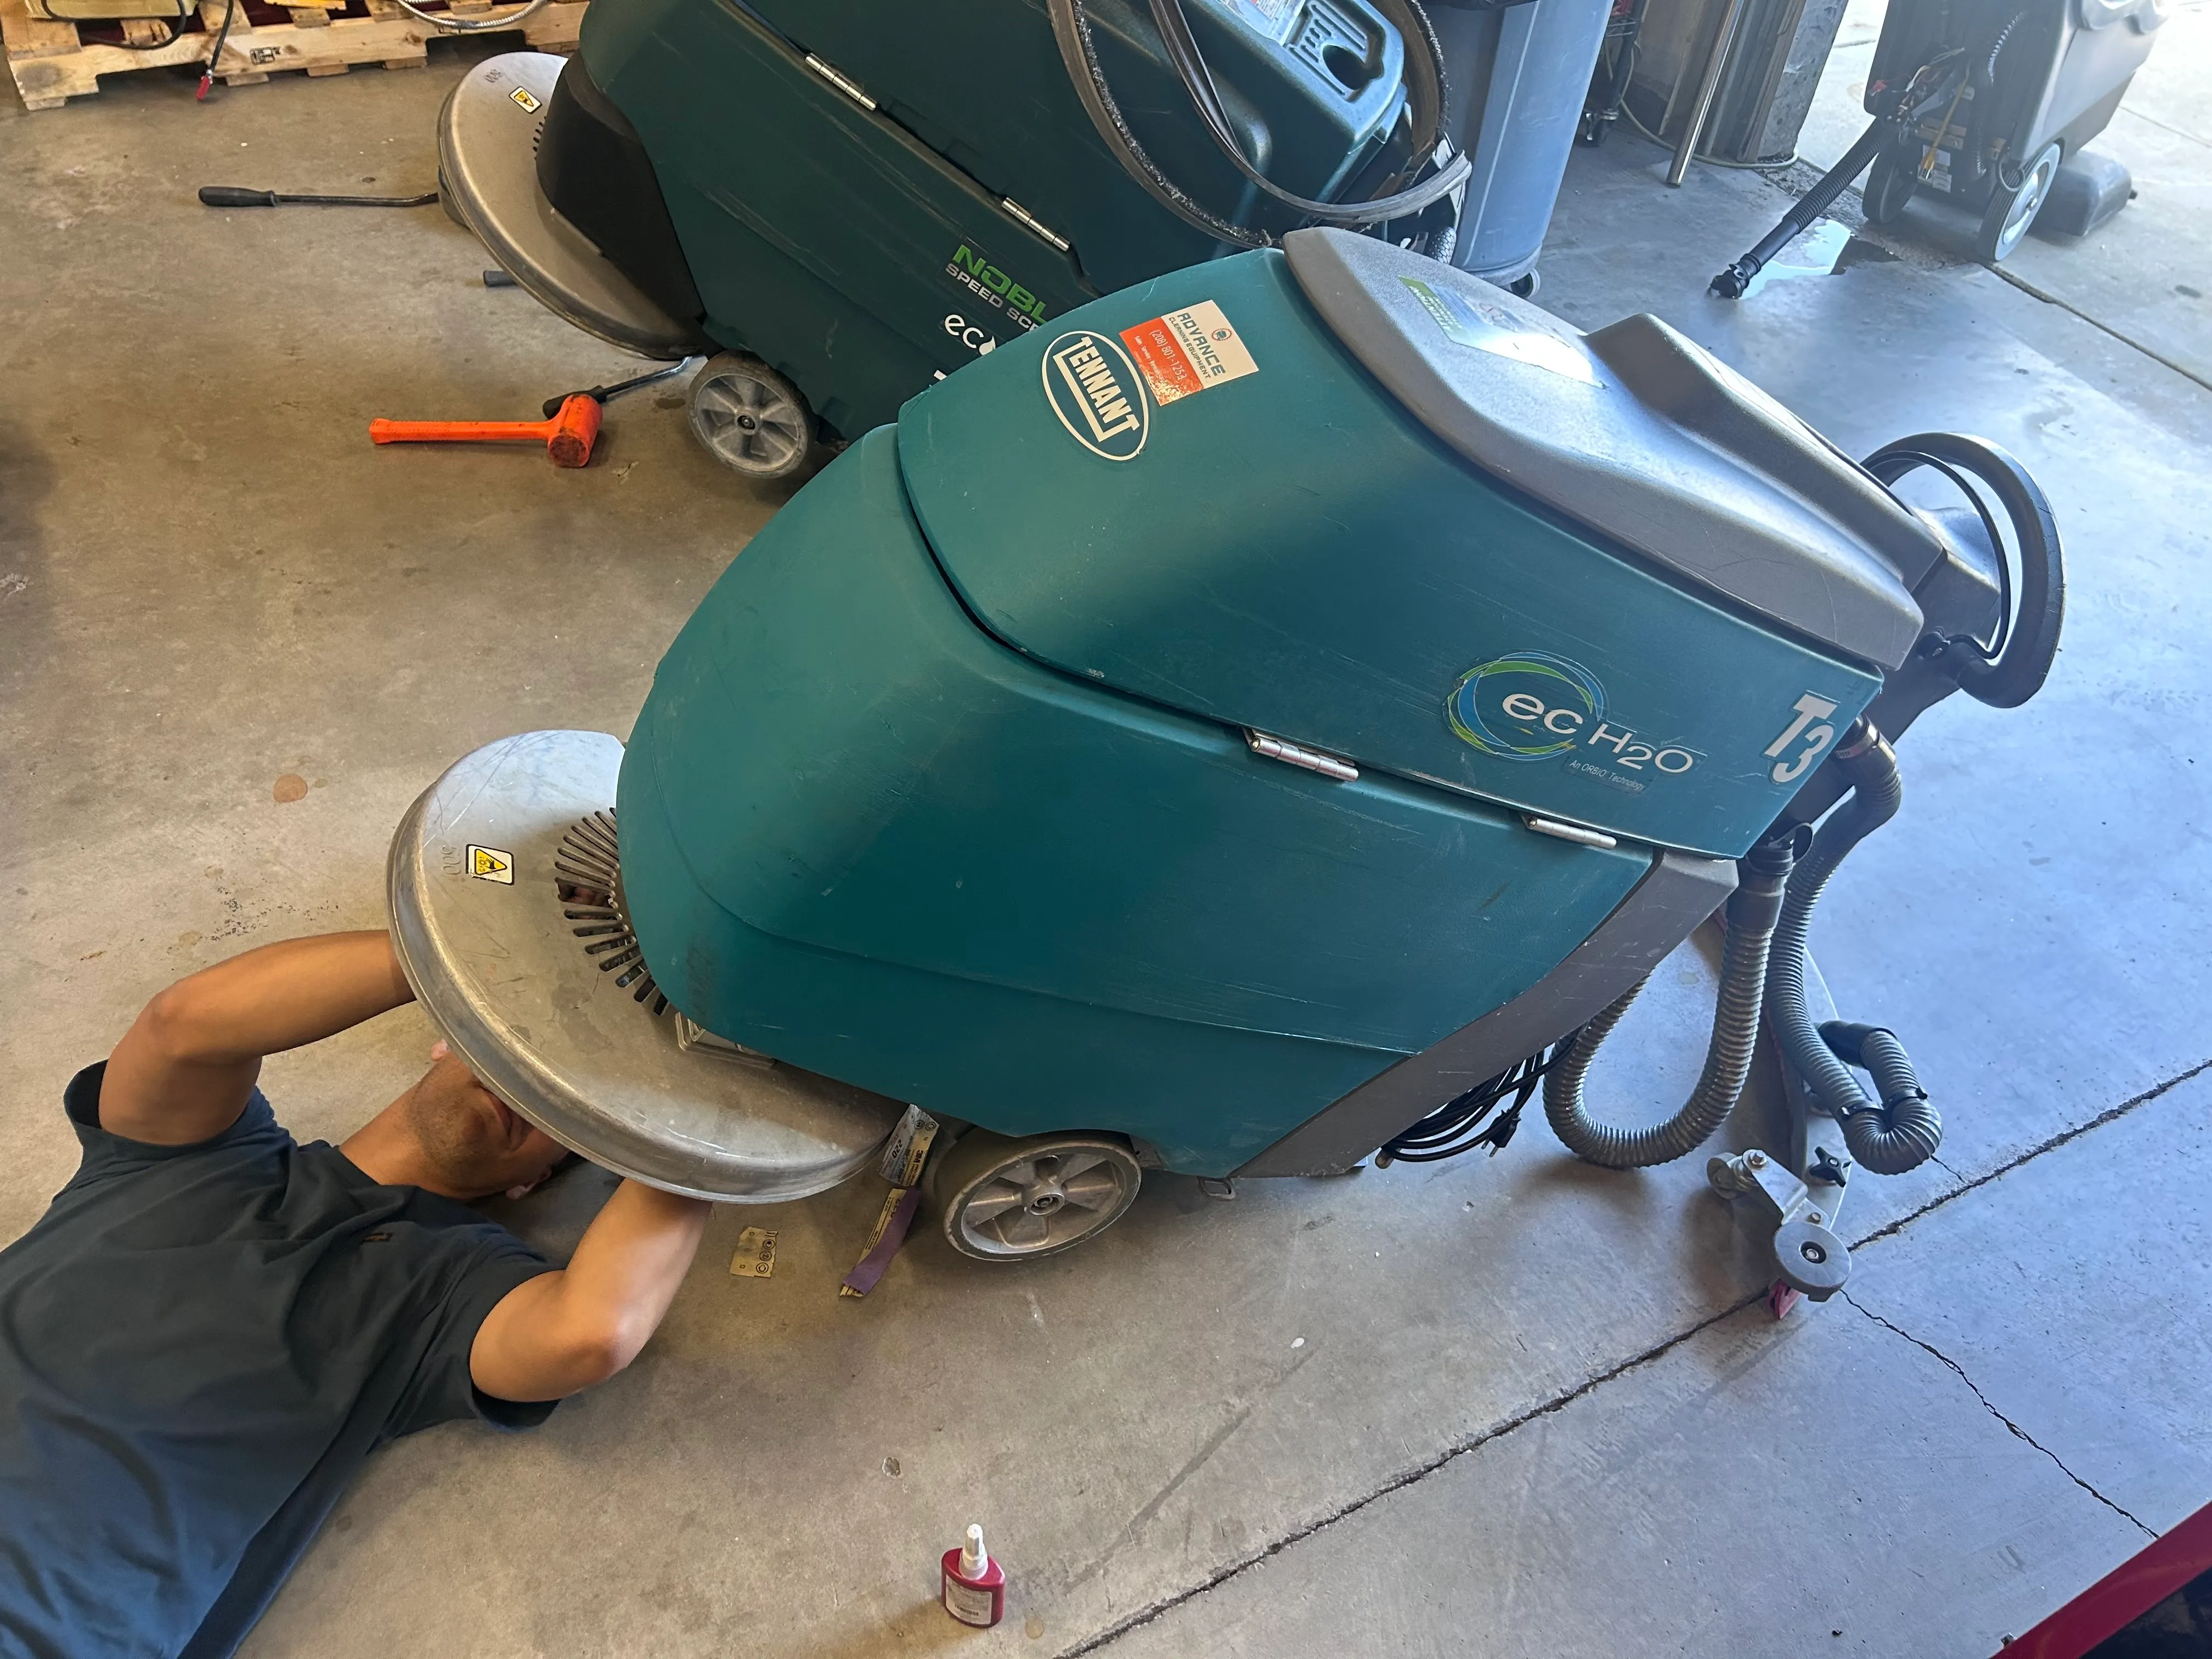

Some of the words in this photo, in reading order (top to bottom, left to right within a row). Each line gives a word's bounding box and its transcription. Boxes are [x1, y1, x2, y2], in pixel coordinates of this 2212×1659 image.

[945, 263, 1003, 308] SPEED
[1149, 329, 1169, 348] (208)
[1169, 317, 1189, 343] CLEANING
[1186, 341, 1211, 379] EQUIPMENT
[1177, 312, 1226, 376] ADVANCE
[1059, 336, 1140, 439] TENNANT
[1764, 693, 1839, 784] T3
[1569, 759, 1579, 769] An
[1609, 772, 1646, 791] Technology
[442, 845, 461, 876] 500
[891, 1139, 903, 1159] 220
[913, 1149, 924, 1163] 3M
